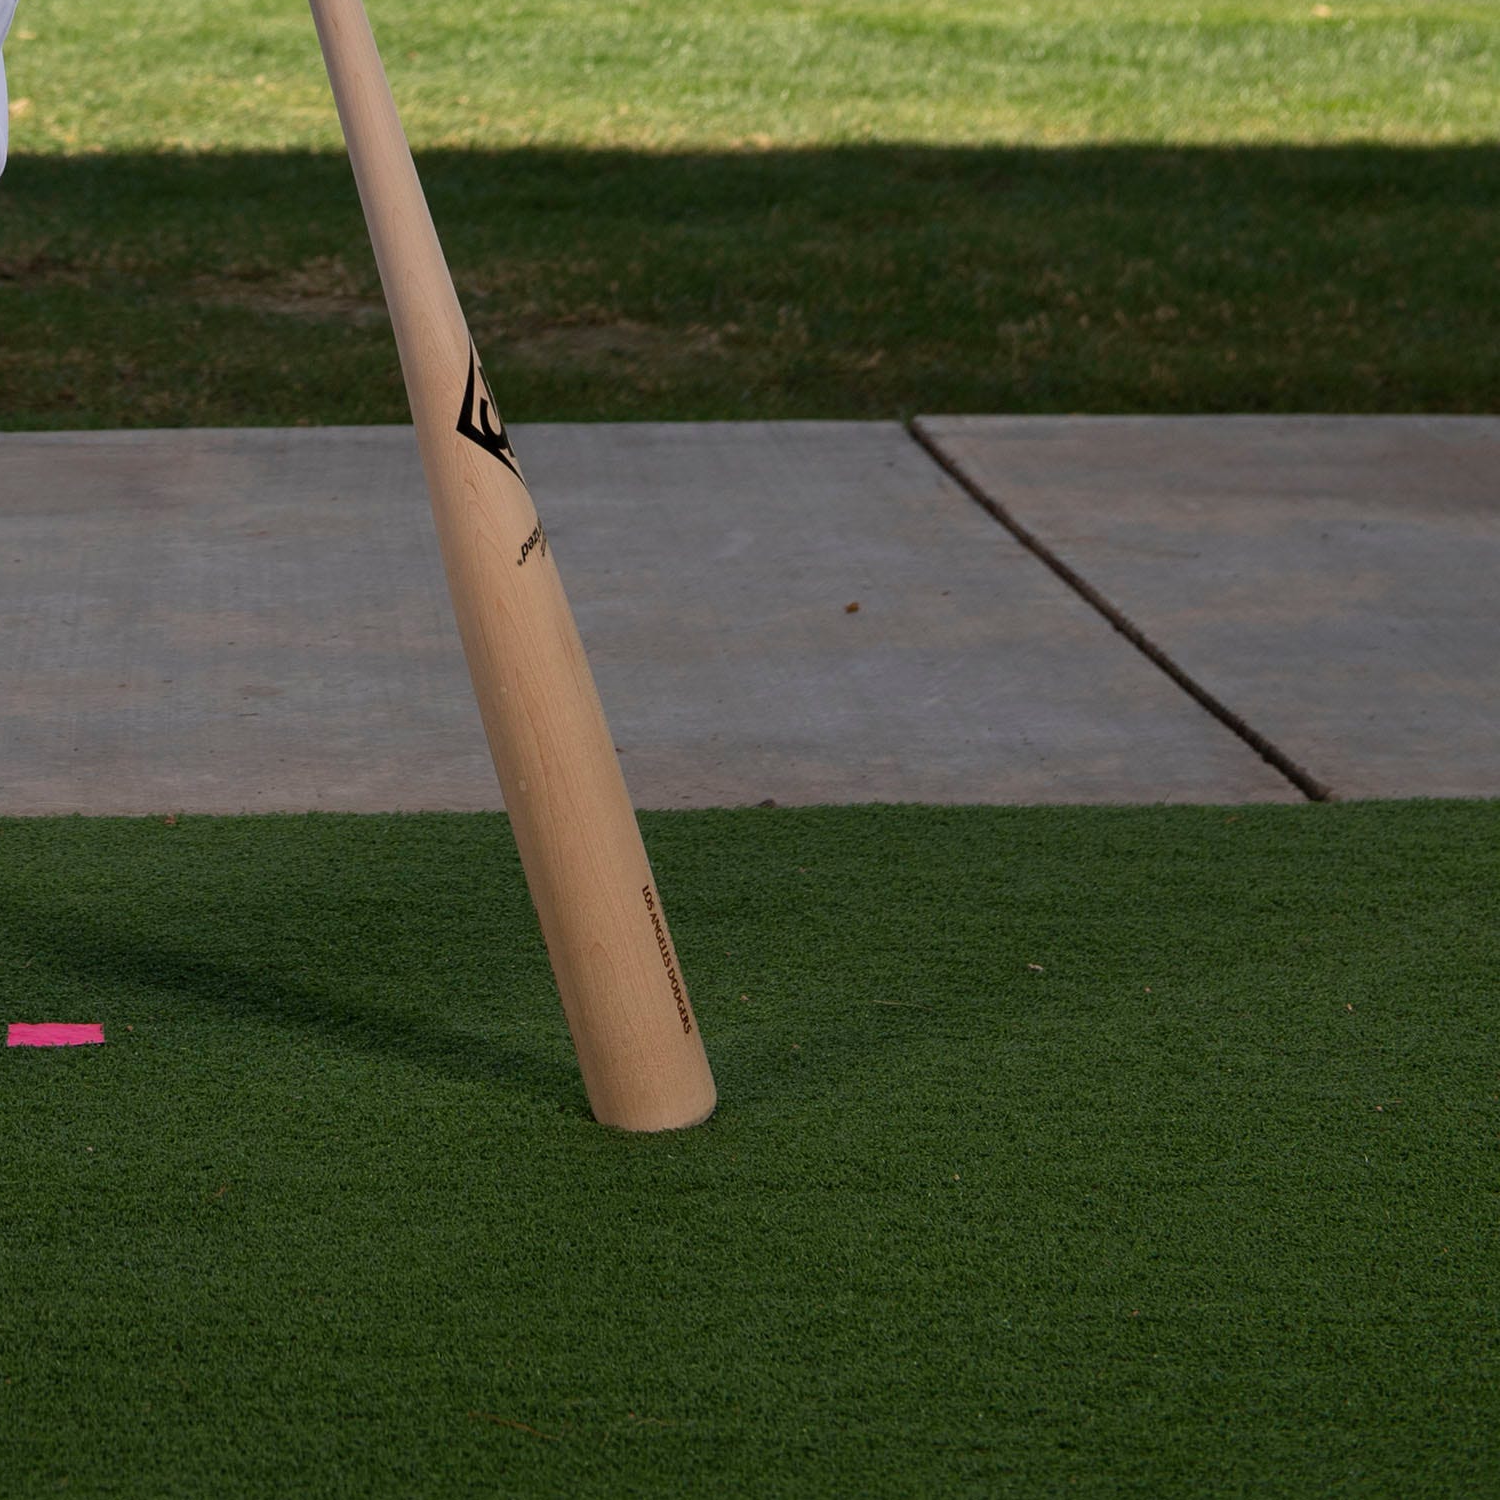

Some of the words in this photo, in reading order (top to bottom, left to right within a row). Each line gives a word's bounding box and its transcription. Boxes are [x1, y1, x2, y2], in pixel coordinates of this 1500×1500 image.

[642, 884, 655, 911] LOS
[650, 912, 672, 968] ANGELES
[667, 967, 692, 1034] DODGERS
